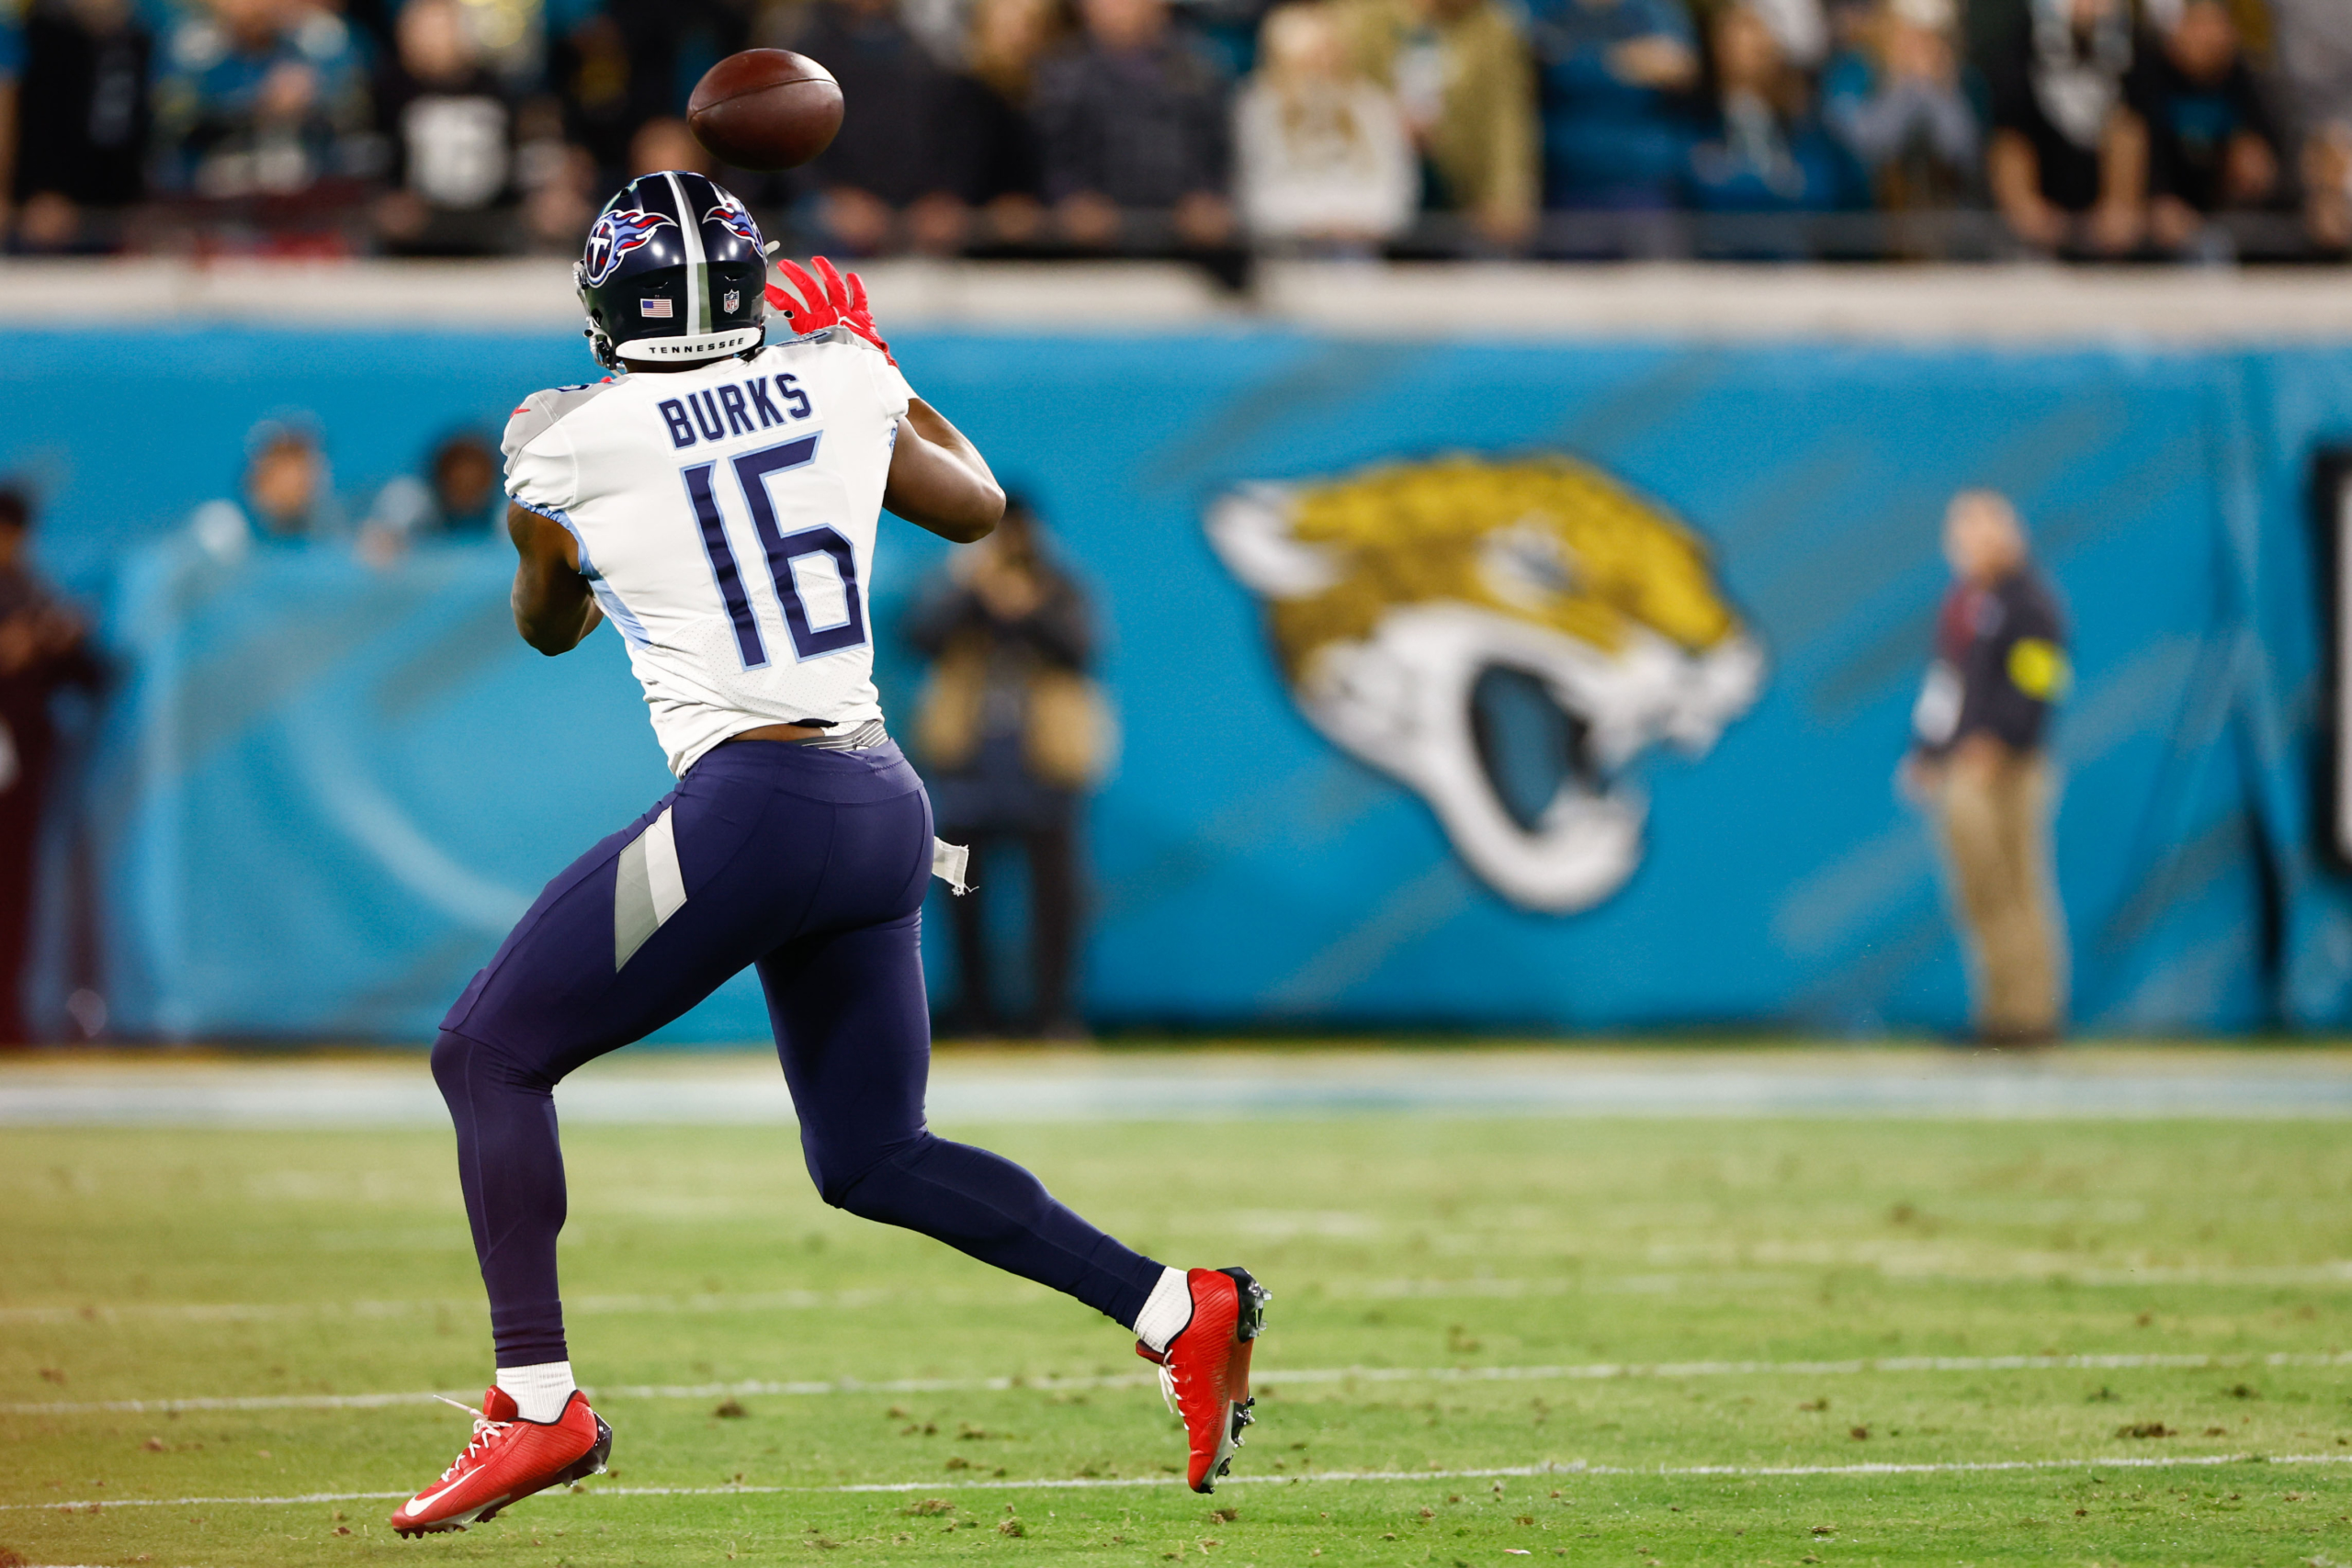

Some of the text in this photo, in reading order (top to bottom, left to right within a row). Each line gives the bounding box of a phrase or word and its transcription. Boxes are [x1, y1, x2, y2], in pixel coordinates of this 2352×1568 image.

[726, 299, 738, 310] NFL
[649, 337, 743, 354] TENNESSEE
[656, 372, 812, 451] BURKS
[679, 430, 866, 671] 16
